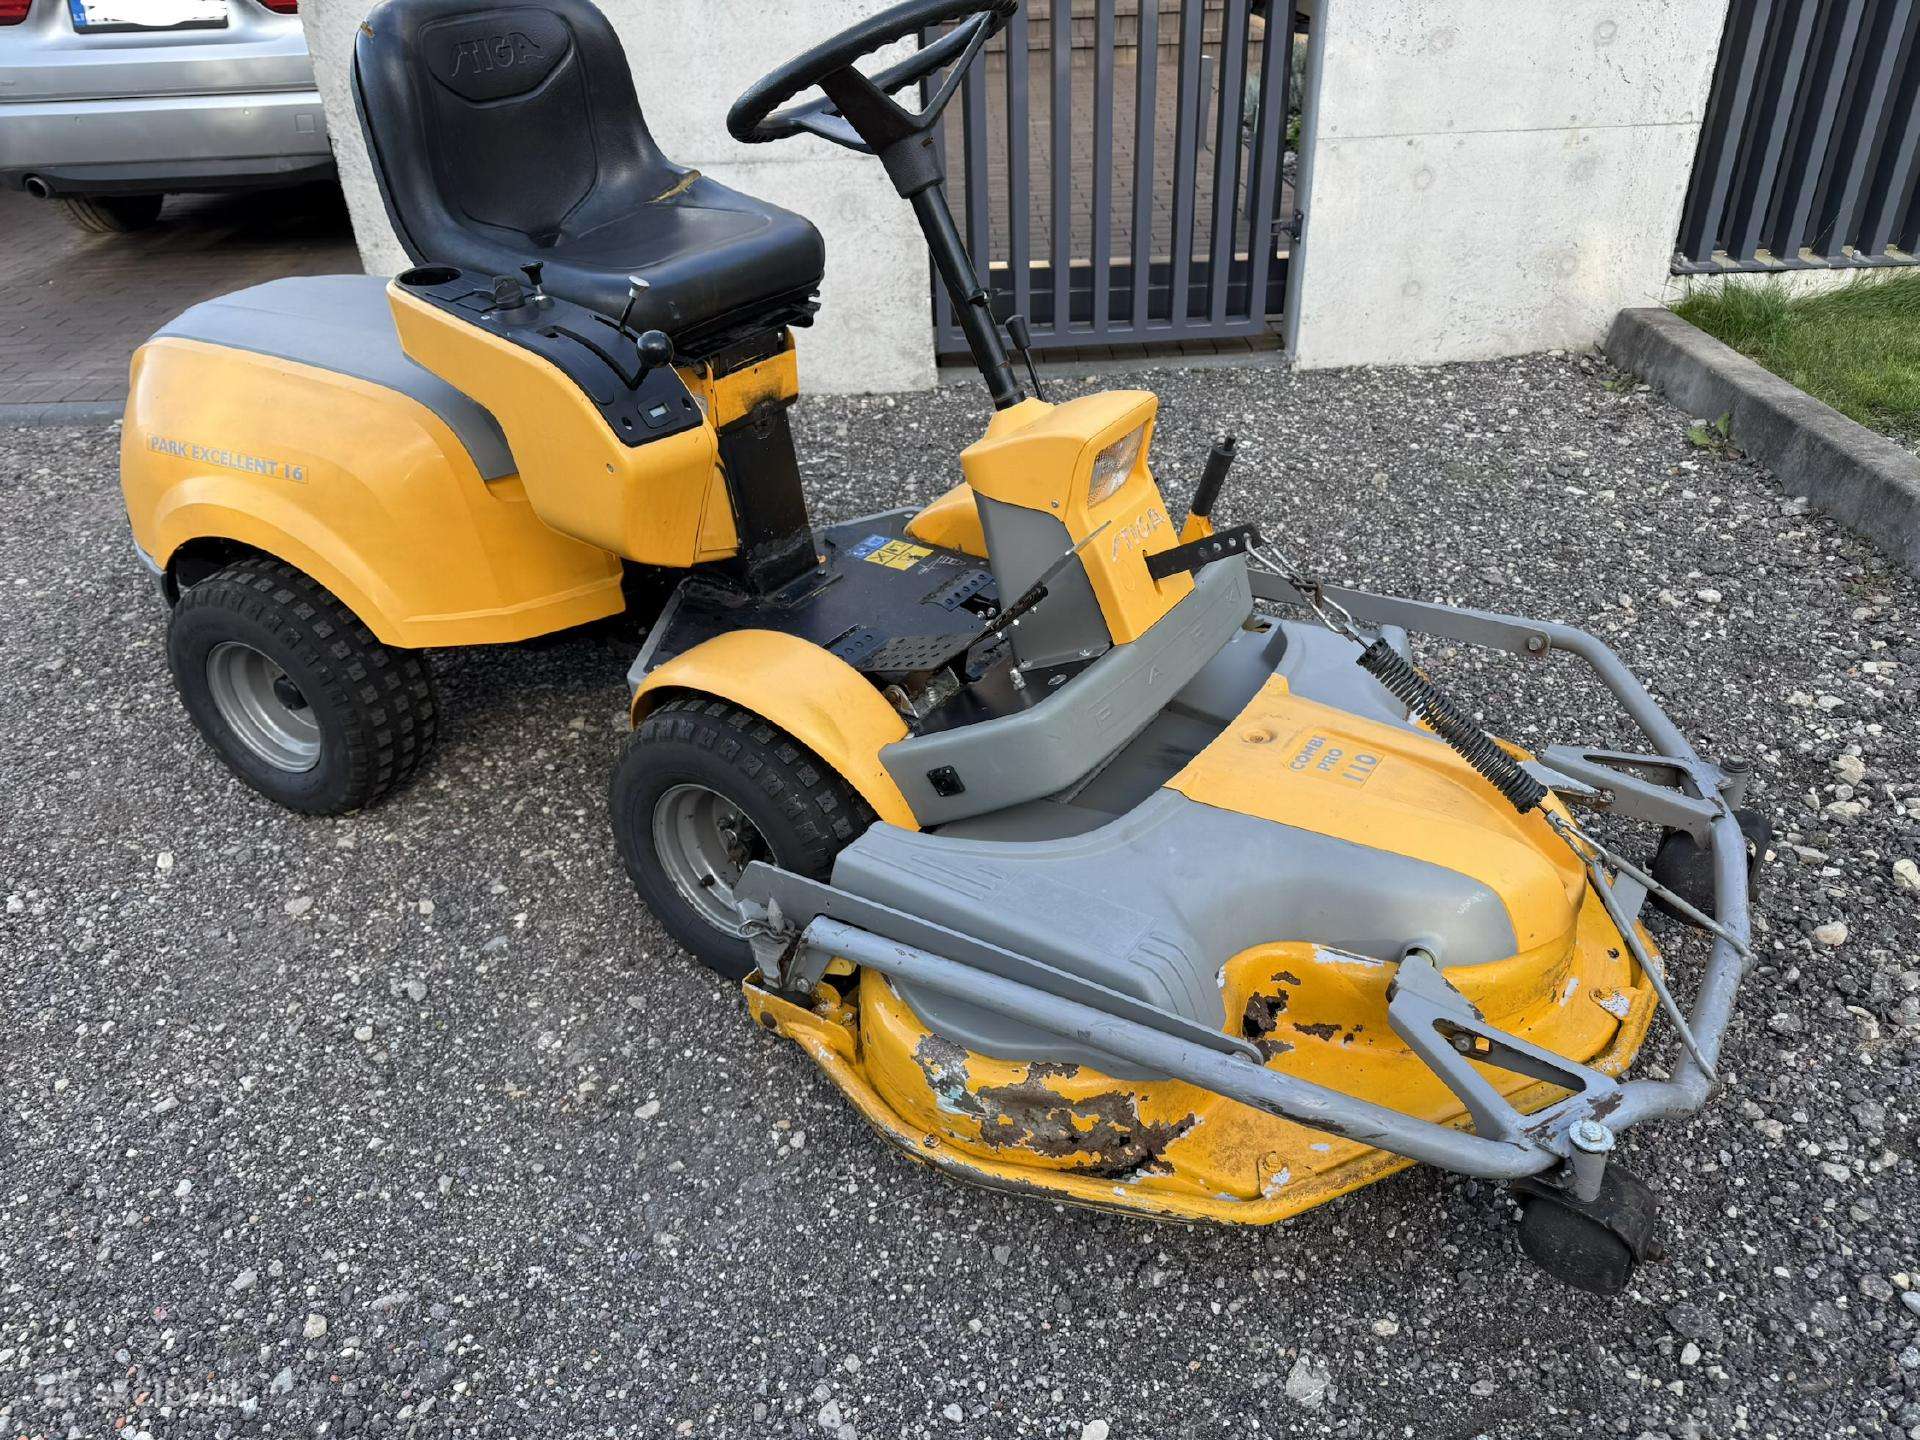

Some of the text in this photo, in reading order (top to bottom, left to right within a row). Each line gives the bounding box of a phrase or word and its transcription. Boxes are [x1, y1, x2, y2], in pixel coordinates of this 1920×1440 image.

[450, 32, 545, 77] STIGA
[151, 436, 304, 481] PARK EXCELLENT 16
[1111, 506, 1166, 563] STIGA
[1290, 735, 1327, 770] COMBI
[1317, 748, 1344, 771] PRO
[1342, 753, 1377, 782] 110
